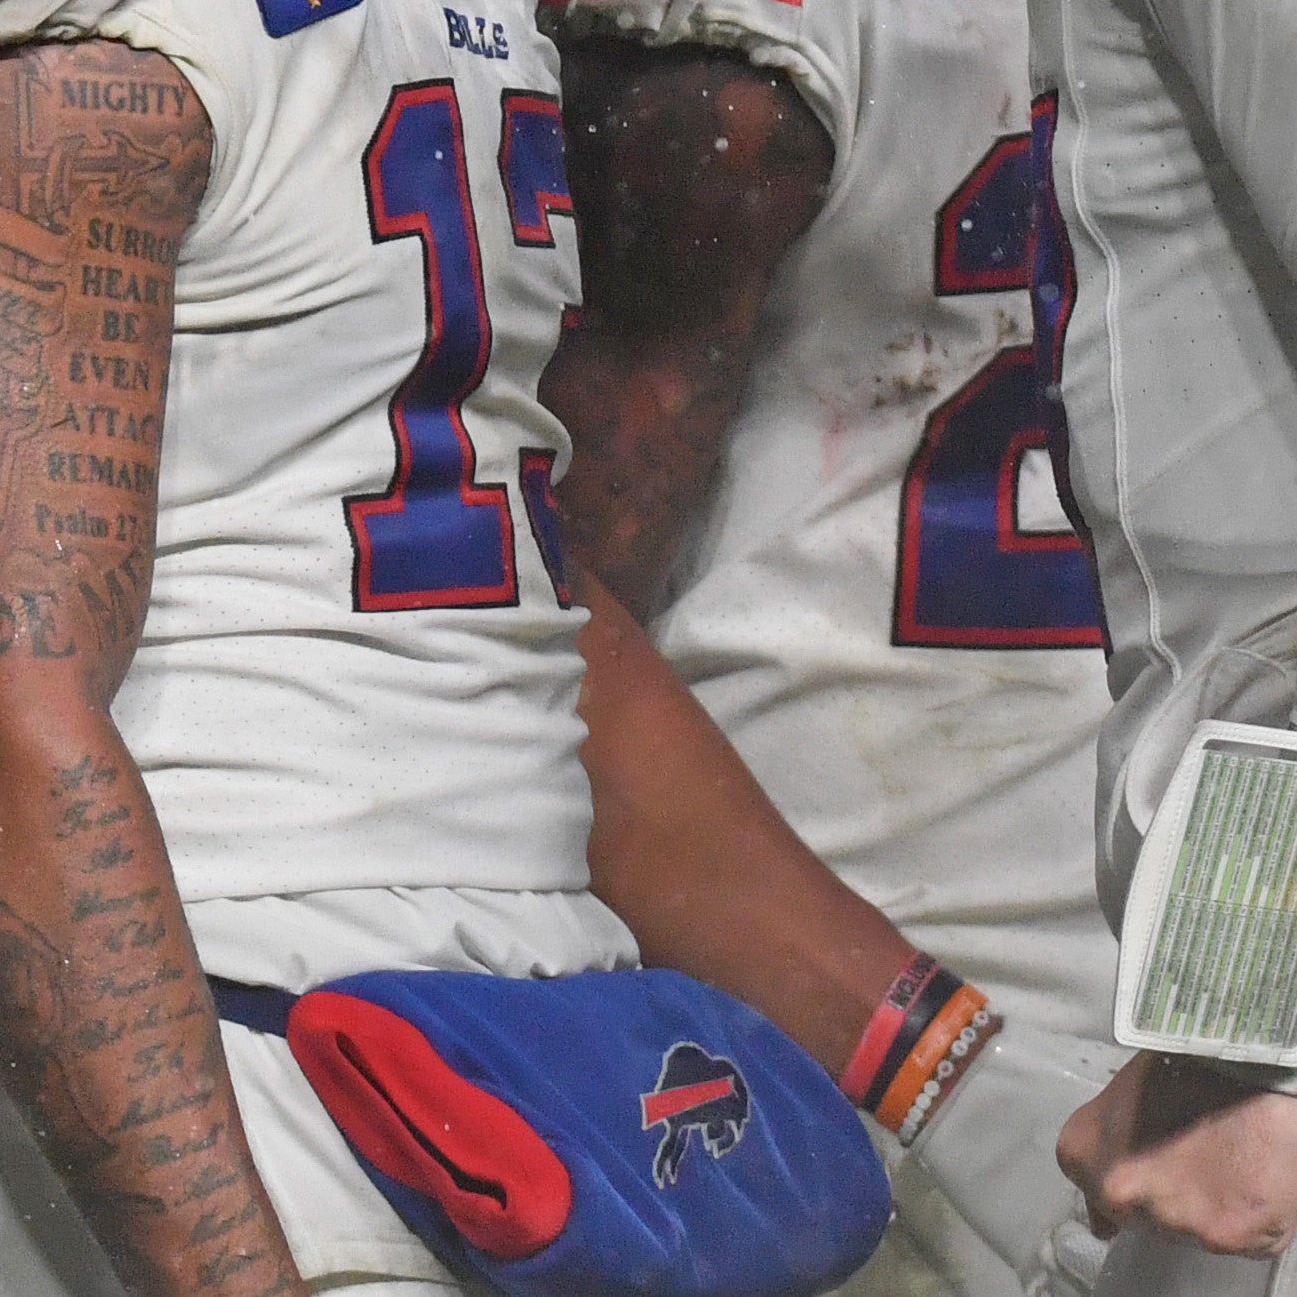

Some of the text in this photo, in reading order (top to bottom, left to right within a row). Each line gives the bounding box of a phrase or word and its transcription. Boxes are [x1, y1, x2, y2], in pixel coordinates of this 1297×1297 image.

[61, 79, 189, 118] MIGHTY
[101, 310, 141, 344] BE
[69, 351, 150, 392] EVEN
